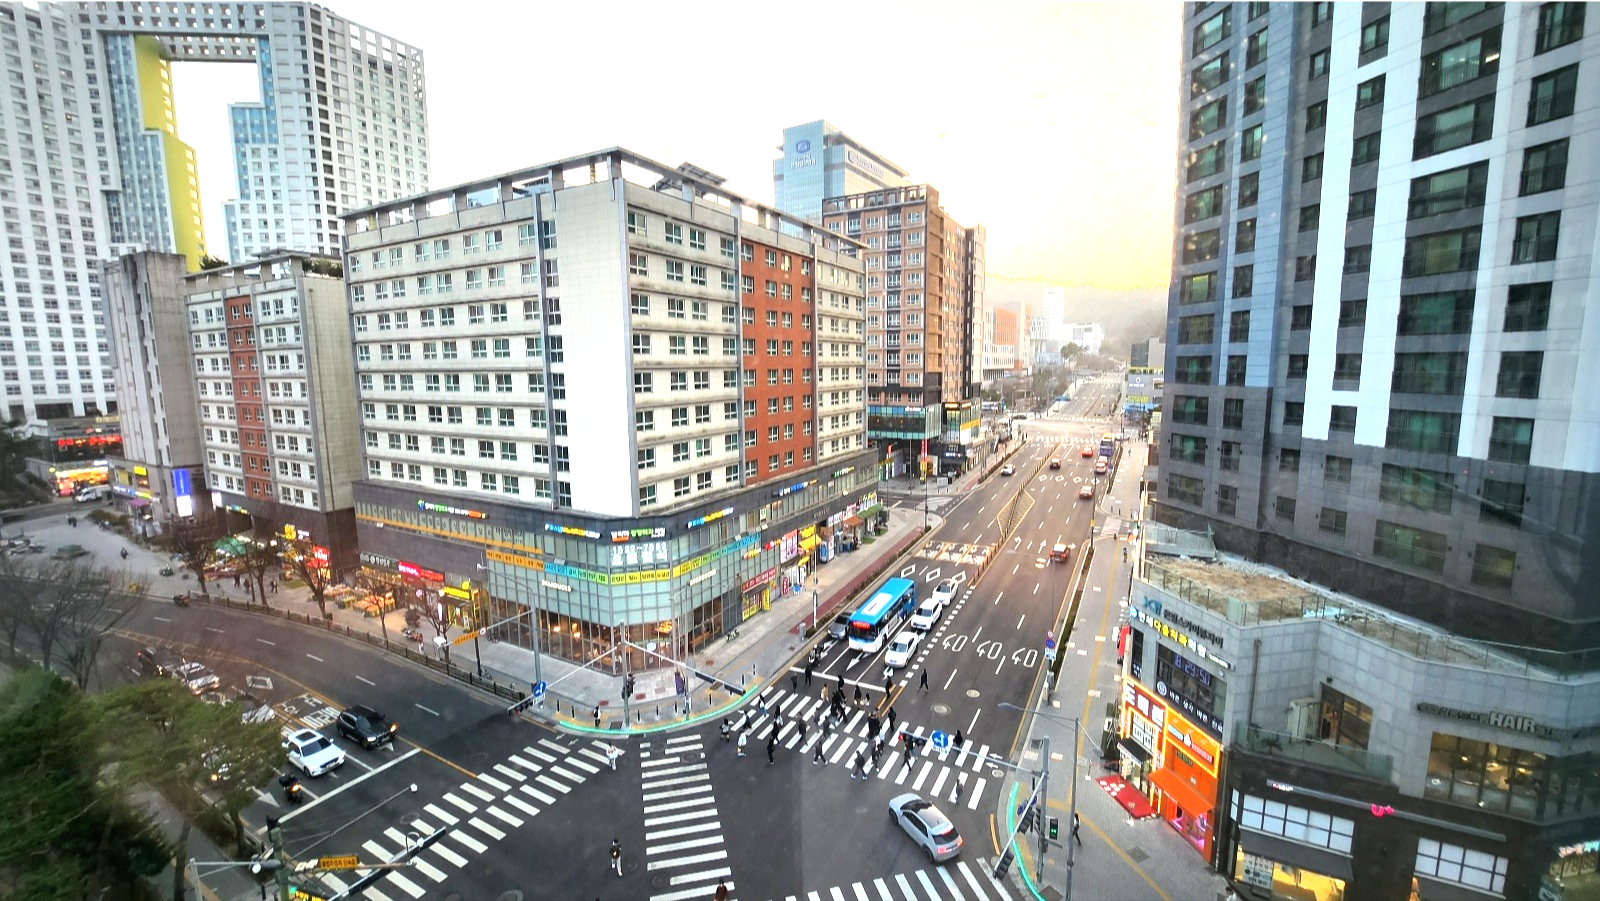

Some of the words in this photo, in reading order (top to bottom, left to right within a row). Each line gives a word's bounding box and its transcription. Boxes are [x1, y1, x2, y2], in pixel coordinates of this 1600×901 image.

[942, 633, 968, 652] 40
[977, 640, 1003, 660] 40
[1011, 647, 1038, 668] 40
[1489, 710, 1536, 733] HAIR
